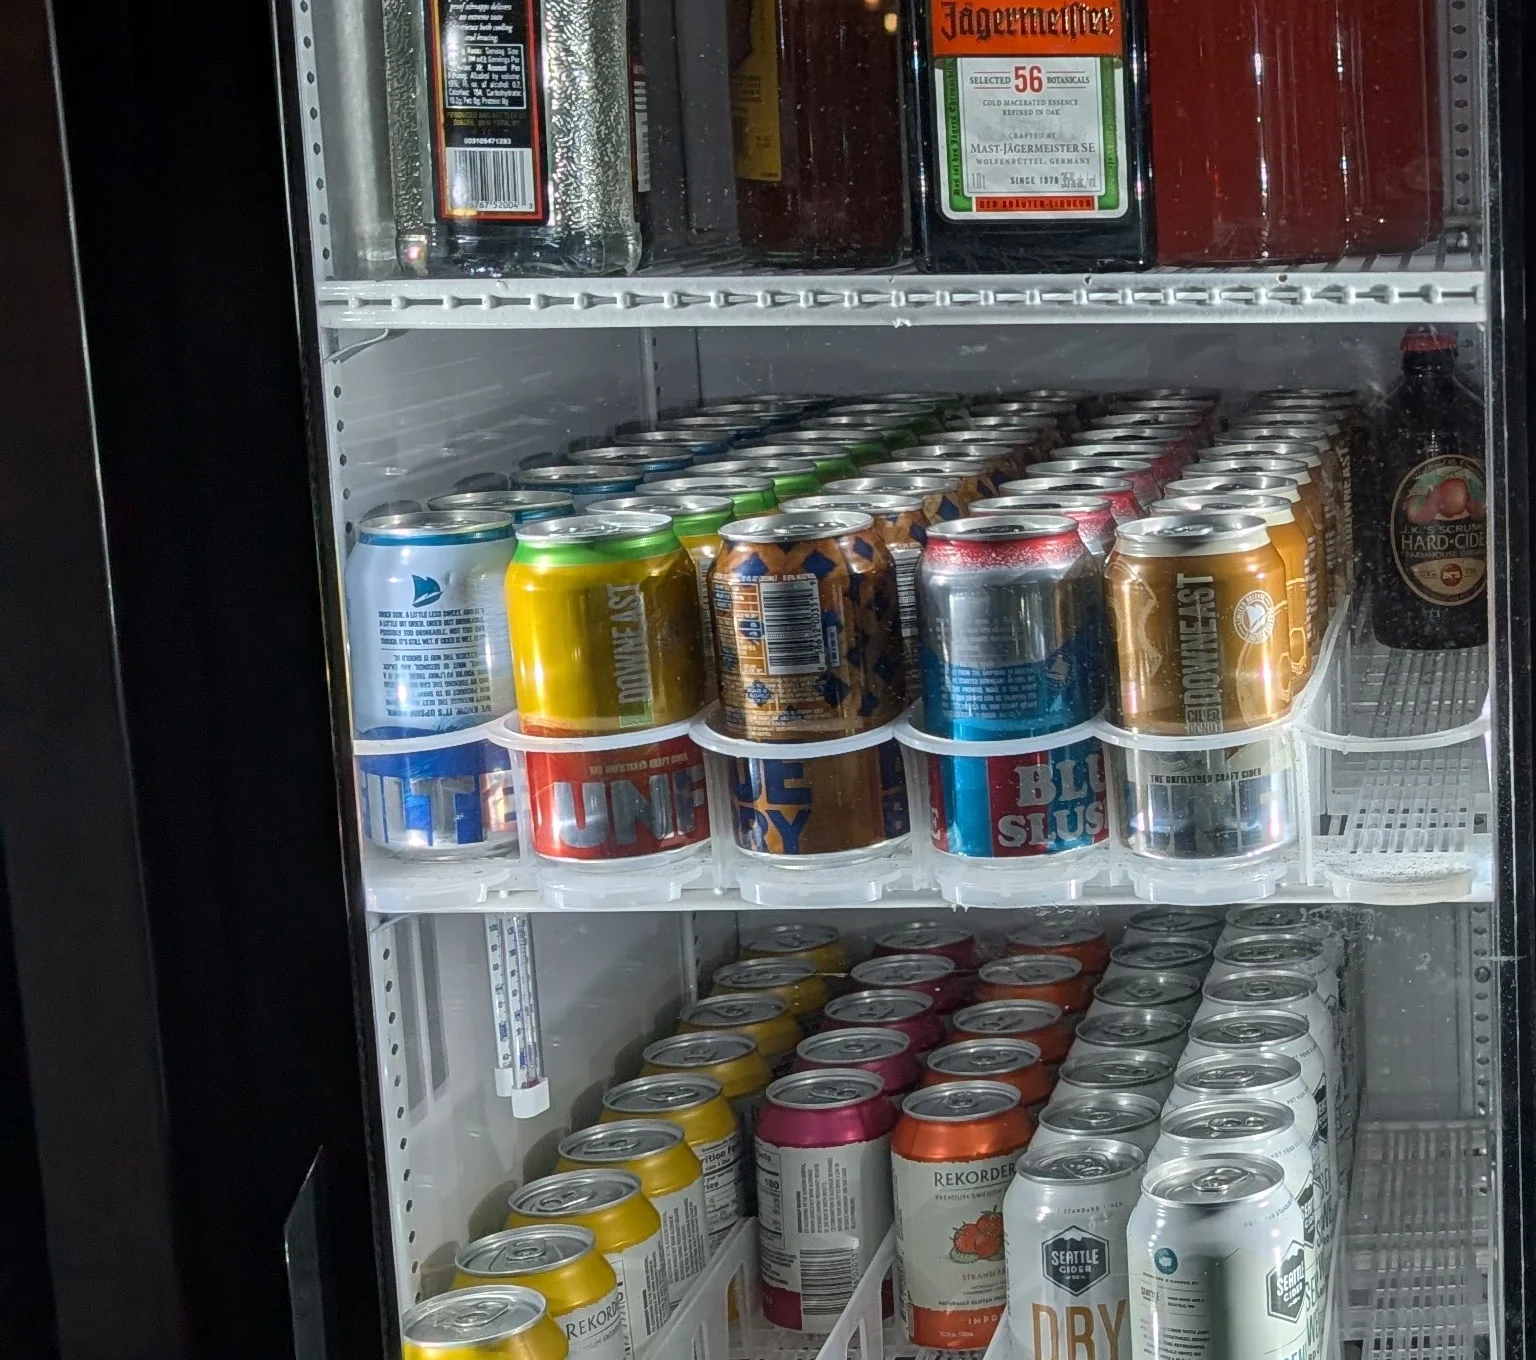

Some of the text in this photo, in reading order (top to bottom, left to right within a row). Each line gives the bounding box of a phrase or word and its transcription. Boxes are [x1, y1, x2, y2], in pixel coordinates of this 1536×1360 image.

[970, 65, 1090, 93] SELECTED 56 BOTANICALS
[970, 142, 1096, 155] MAST-JÄGERMEISTER SE
[1050, 157, 1091, 165] GERMANY
[1010, 177, 1036, 185] SINCE
[1401, 535, 1449, 551] HARD
[607, 583, 653, 704] DOWNEAST
[1177, 573, 1221, 707] DOWNEAST
[1187, 709, 1220, 723] CIDER
[1151, 775, 1163, 783] THE
[1215, 772, 1239, 782] CRAFT
[1052, 1248, 1099, 1266] SEATTLE
[1059, 1265, 1092, 1274] CIDER
